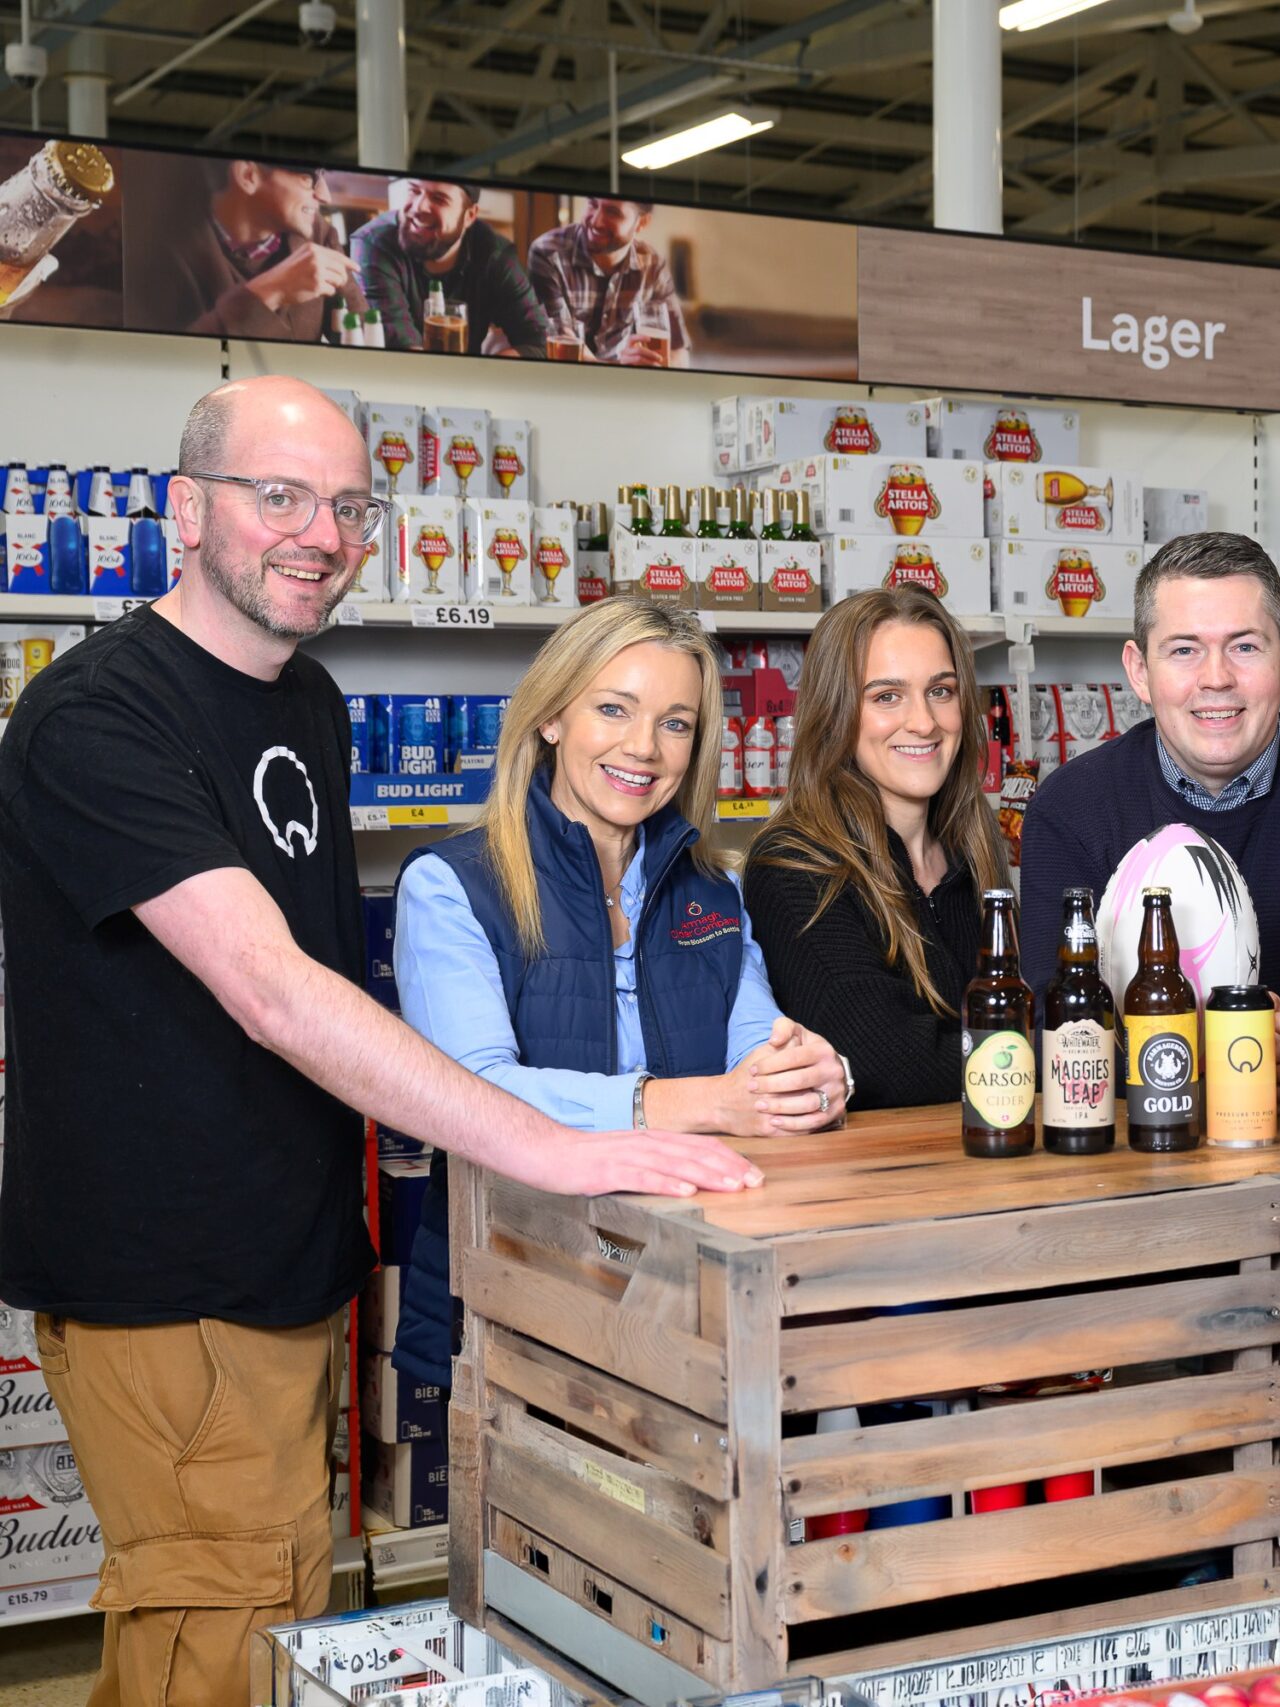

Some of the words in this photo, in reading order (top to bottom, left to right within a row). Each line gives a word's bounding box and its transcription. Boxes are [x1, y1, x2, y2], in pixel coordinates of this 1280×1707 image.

[1082, 296, 1226, 370] Lager
[835, 428, 869, 438] STELLA
[835, 437, 870, 447] ARTOIS
[996, 433, 1030, 444] STELLA
[995, 443, 1031, 454] ARTOIS
[888, 489, 927, 499] STELLA
[888, 499, 928, 511] ARTOIS
[1065, 509, 1095, 519] STELLA
[1065, 517, 1096, 527] ARTOIS
[421, 539, 446, 547] STELLA
[494, 542, 519, 550] STELLA
[421, 546, 447, 554] ARTOIS
[494, 548, 520, 556] ARTOIS
[539, 551, 562, 559] STELLA
[539, 556, 563, 564] ARTOIS
[650, 570, 681, 578] STELLA
[714, 571, 744, 579] STELLA
[777, 572, 806, 580] STELLA
[895, 568, 935, 579] STELLA
[1057, 572, 1093, 583] STELLA
[579, 580, 602, 590] TELLA
[650, 578, 681, 586] ARTOIS
[714, 579, 744, 587] ARTOIS
[777, 580, 807, 588] ARTOIS
[579, 588, 603, 597] RTOIS
[1057, 582, 1094, 593] ARTOIS
[436, 607, 490, 624] £6.19
[401, 746, 435, 760] BUD
[377, 785, 413, 798] BUD
[415, 784, 464, 797] LIGHT
[411, 809, 424, 817] £4
[681, 911, 722, 929] Armagh
[670, 929, 693, 939] Cider
[694, 917, 739, 936] Company
[691, 934, 716, 946] Blossom
[1057, 1033, 1101, 1049] WHITEWATER
[986, 1095, 1025, 1106] CIDER
[1063, 1083, 1100, 1109] LEAP
[1144, 1095, 1193, 1113] GOLD
[1075, 1112, 1088, 1120] IPA
[8, 1590, 48, 1606] £15.79
